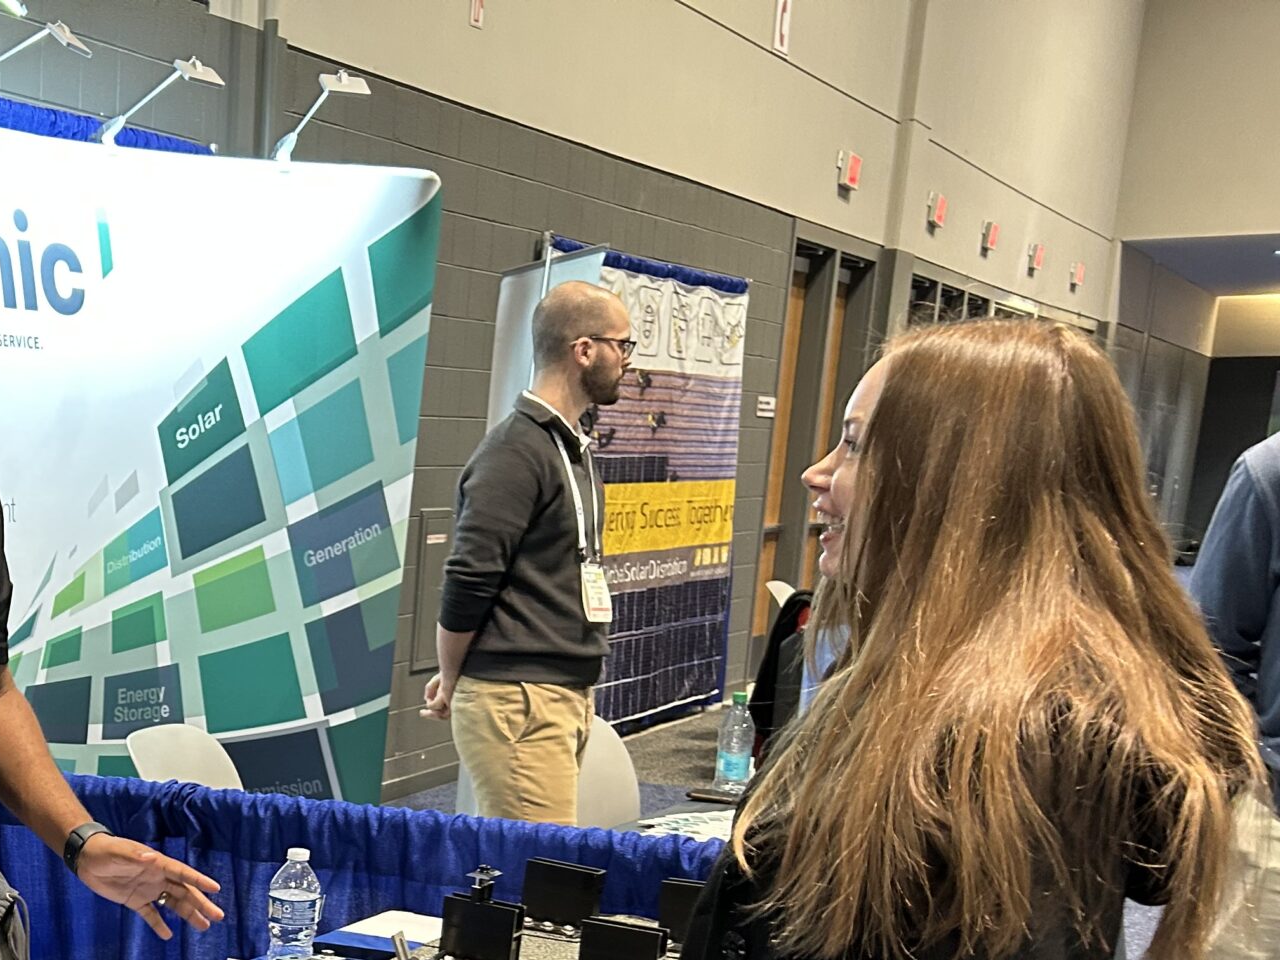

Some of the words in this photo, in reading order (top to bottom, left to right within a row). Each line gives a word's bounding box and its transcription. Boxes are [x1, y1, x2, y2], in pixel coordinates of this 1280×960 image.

[175, 404, 223, 449] Solar
[106, 535, 162, 575] Distribution
[303, 522, 382, 568] Generation
[113, 703, 170, 723] Storage
[117, 686, 166, 705] Energy
